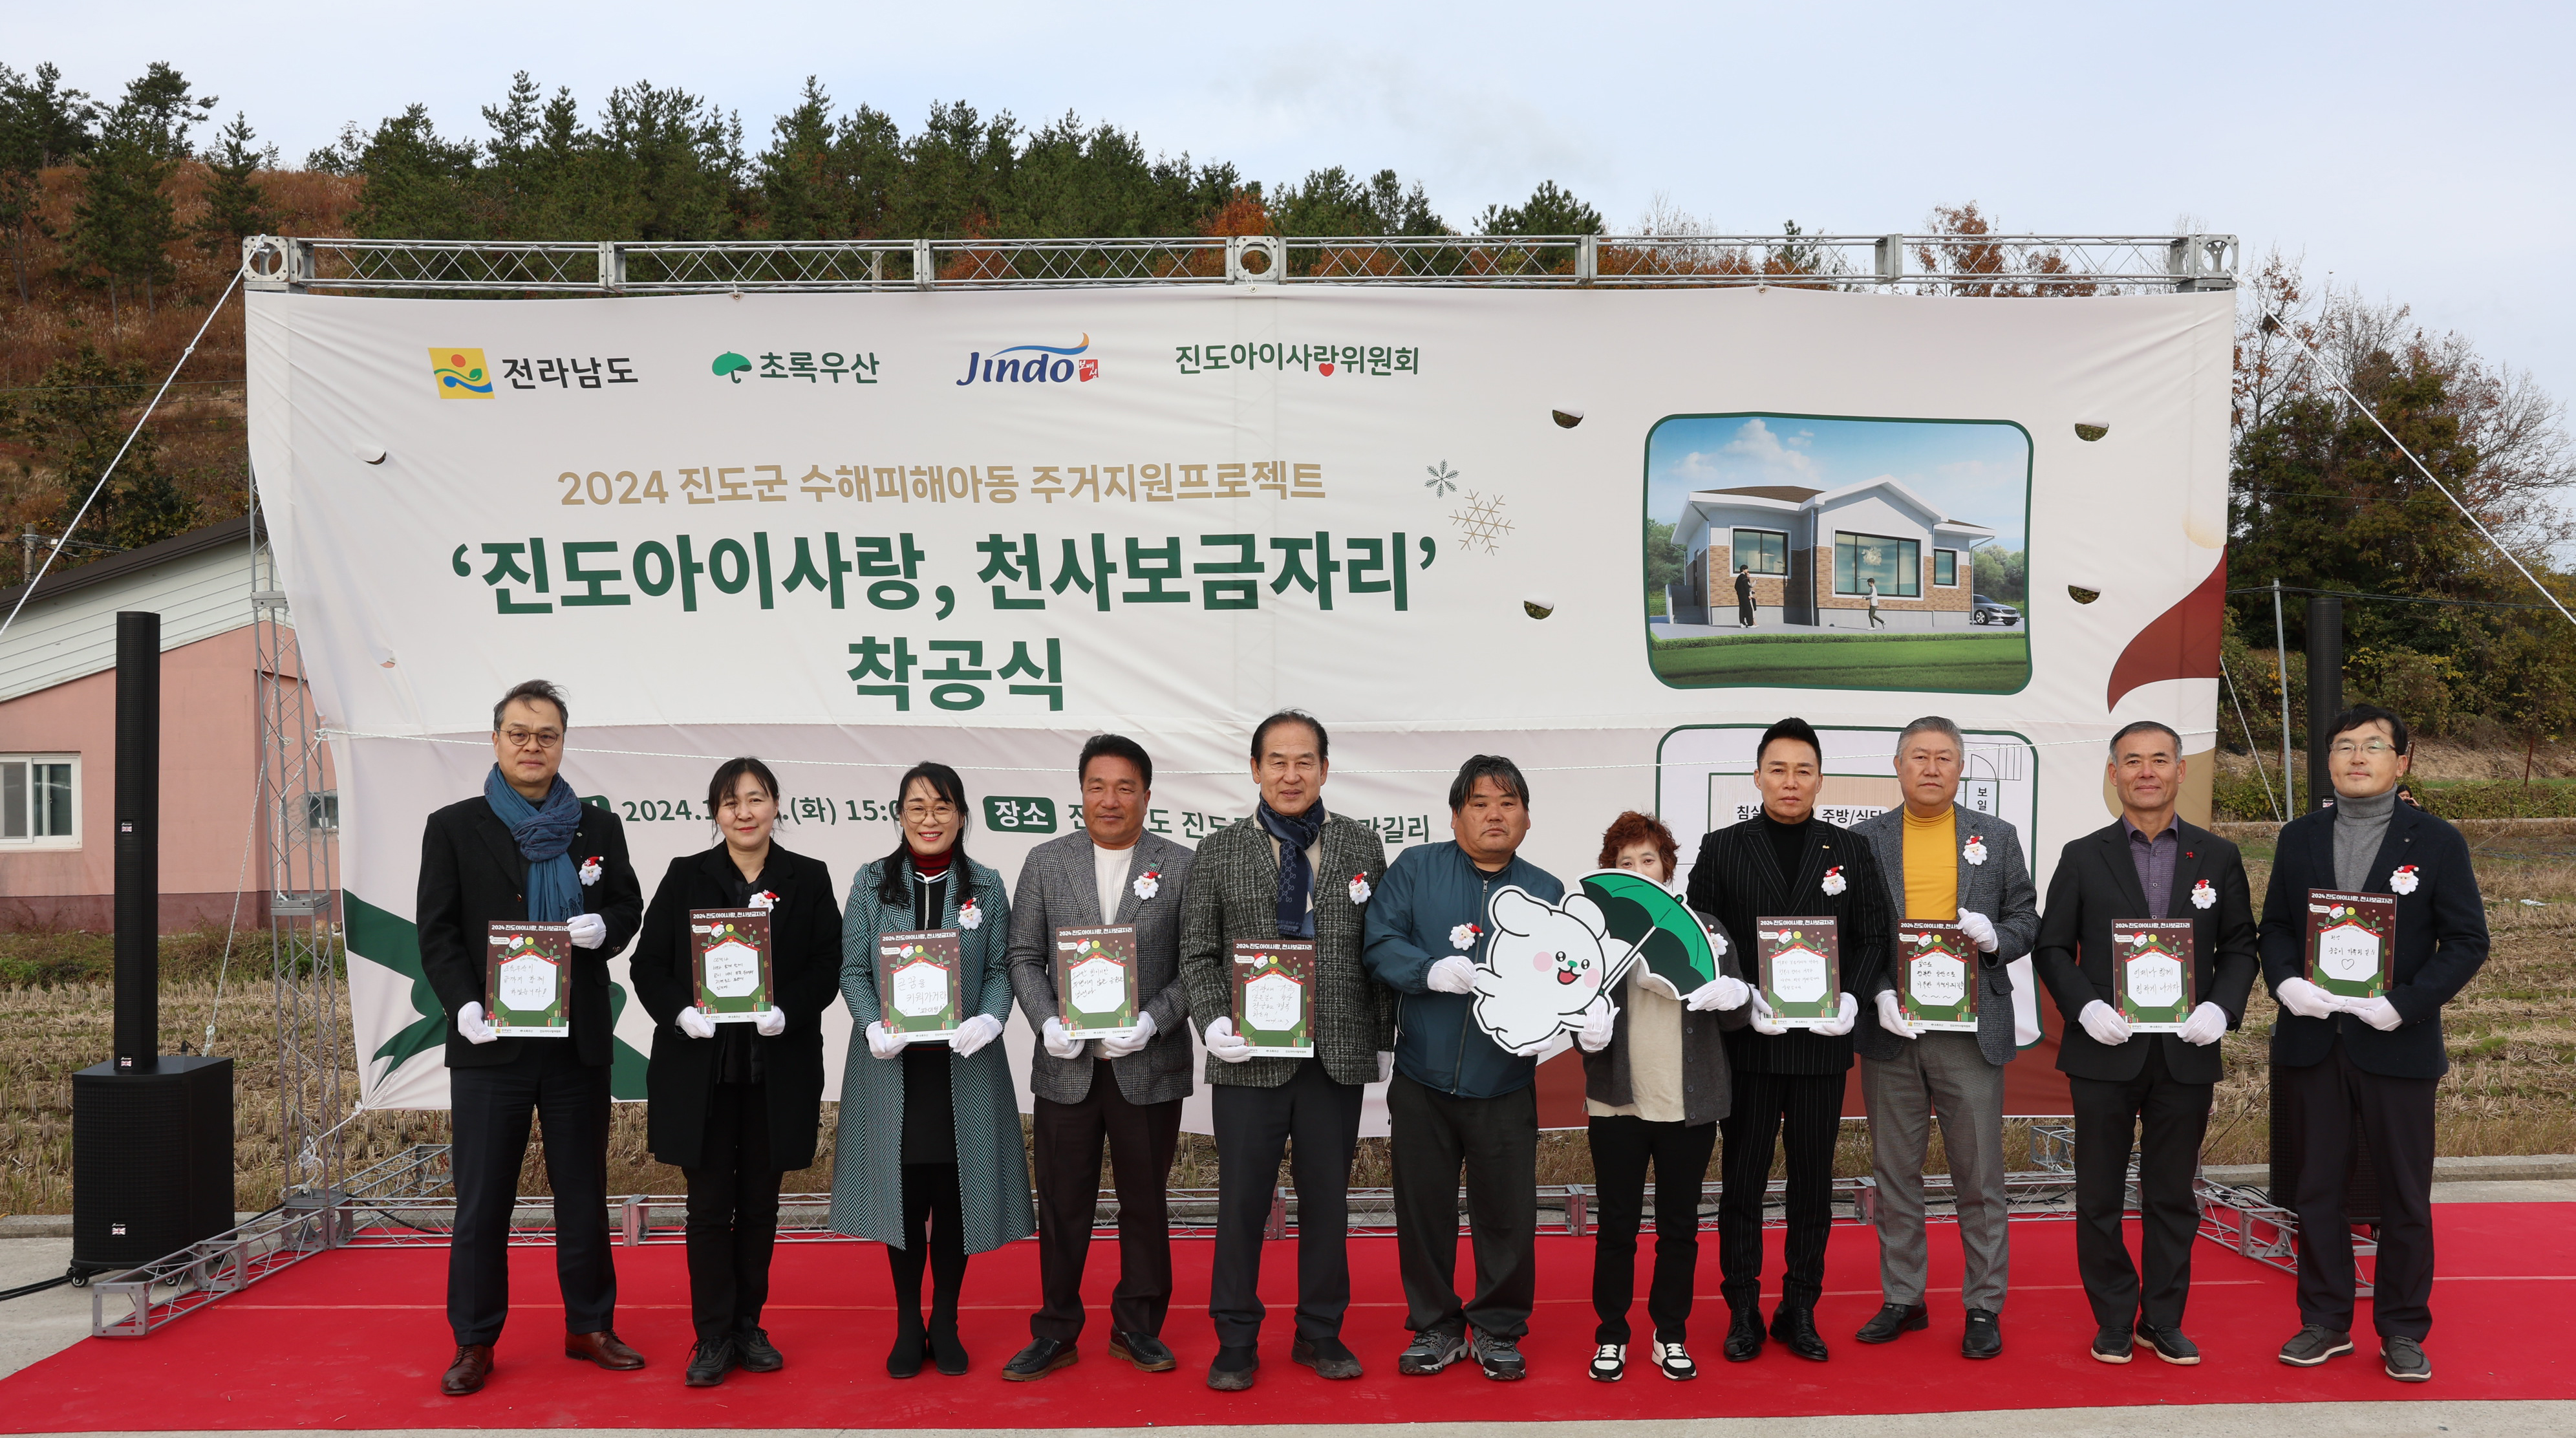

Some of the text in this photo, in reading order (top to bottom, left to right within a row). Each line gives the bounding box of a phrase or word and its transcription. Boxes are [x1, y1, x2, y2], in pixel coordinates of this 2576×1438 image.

[502, 358, 638, 389] 전라남도
[760, 352, 879, 383] 초록우산
[956, 352, 1075, 386] Jindo
[1176, 343, 1418, 376] 진도아이사랑위원회
[557, 461, 1326, 505] 2024 진도군 수해피해아동 주거지원프로젝트
[847, 636, 1064, 711] 착공식
[994, 800, 1049, 827] 장소
